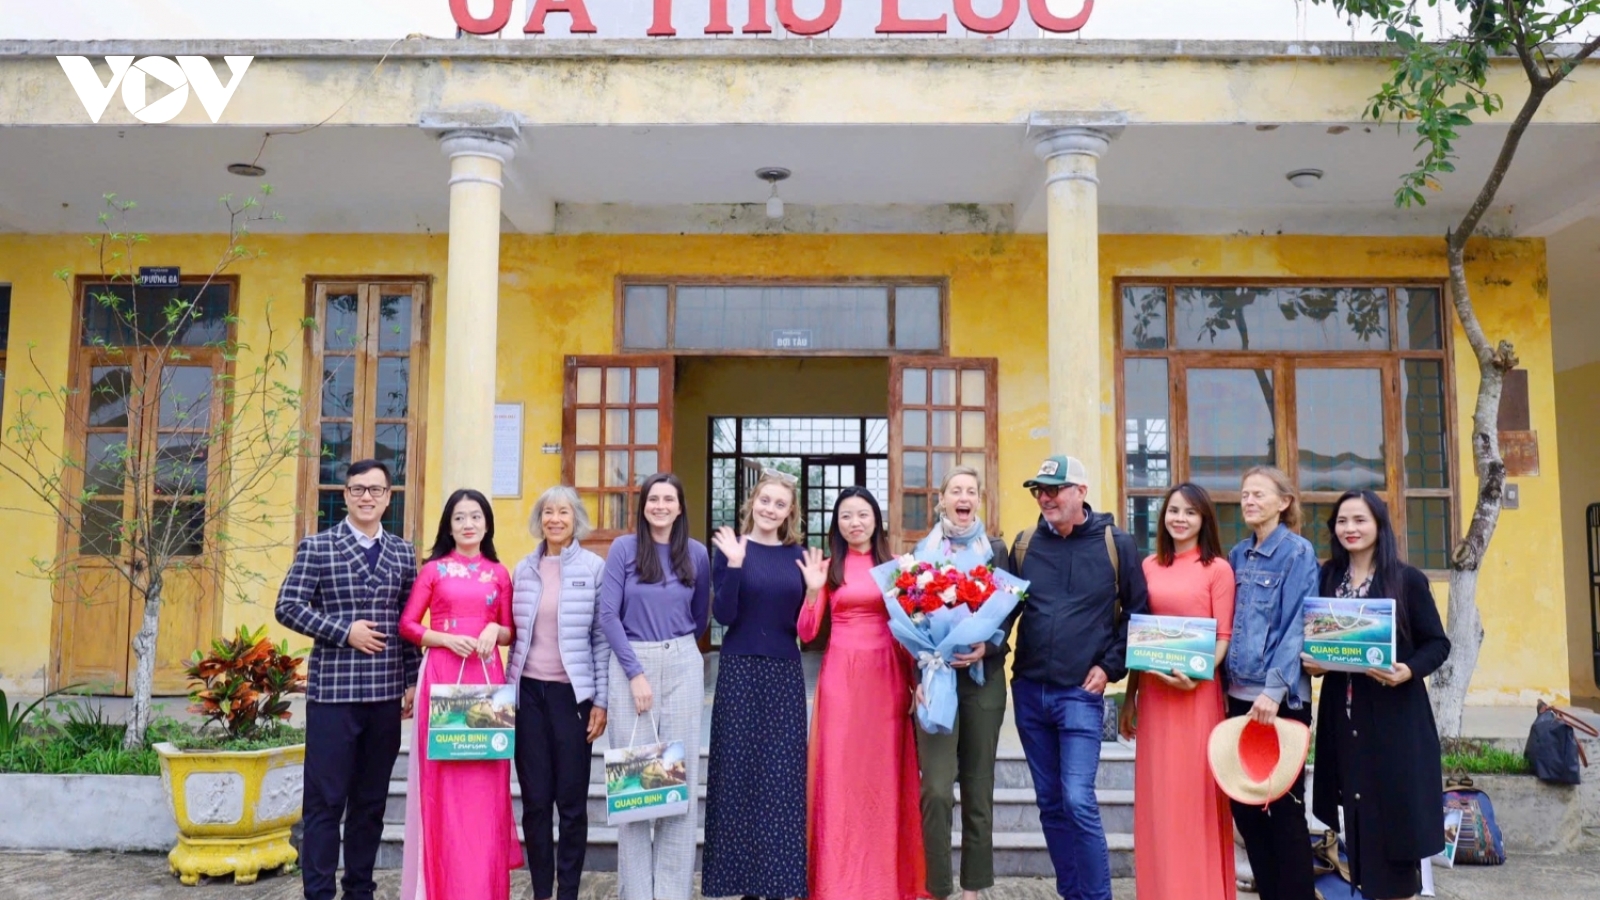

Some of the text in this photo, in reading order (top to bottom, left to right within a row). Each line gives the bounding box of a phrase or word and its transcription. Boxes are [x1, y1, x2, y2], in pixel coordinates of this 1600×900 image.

[168, 275, 178, 284] GA
[1133, 650, 1164, 659] QUANG
[1310, 645, 1340, 655] QUANG
[1150, 657, 1186, 667] Tourism
[1327, 654, 1362, 662] Tourism
[436, 734, 466, 743] QUANG
[614, 797, 643, 808] QUANG
